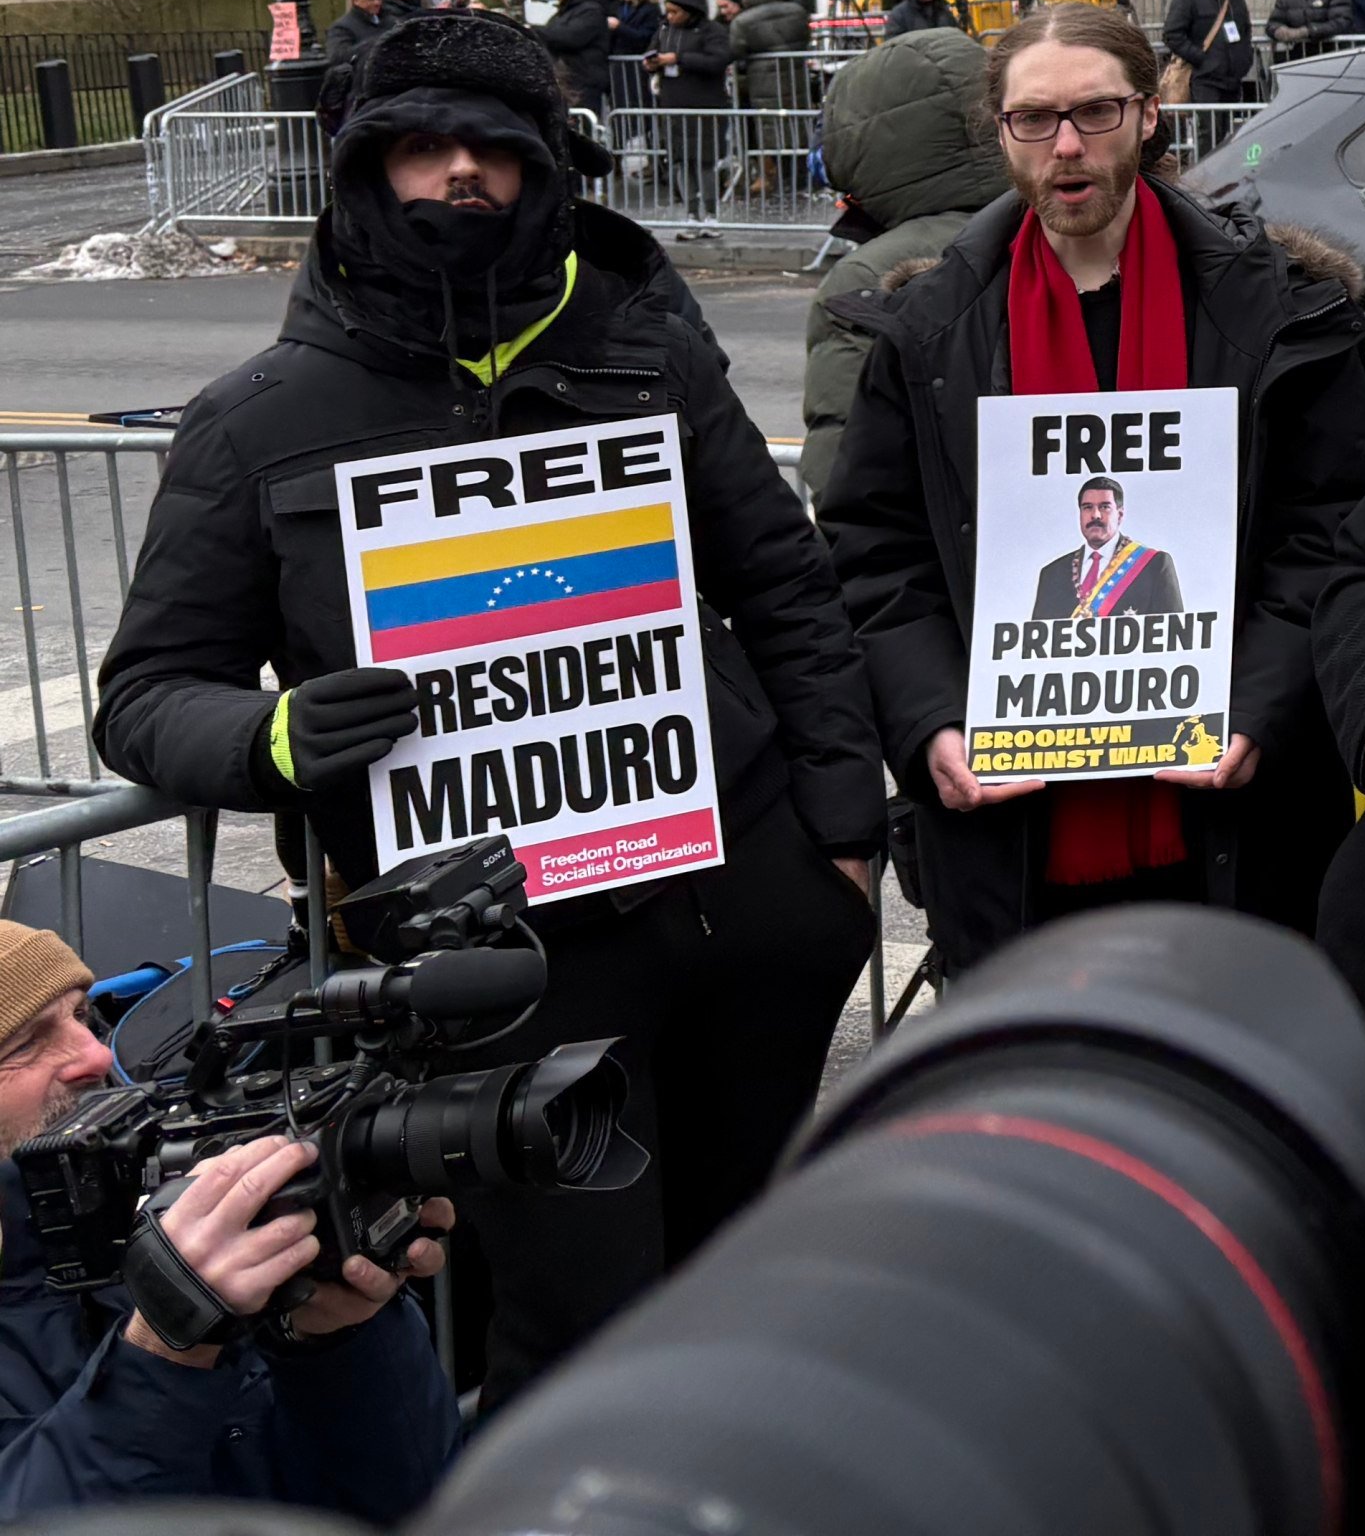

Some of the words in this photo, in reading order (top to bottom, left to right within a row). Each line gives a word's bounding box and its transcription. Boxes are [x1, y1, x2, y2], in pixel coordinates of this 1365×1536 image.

[1031, 411, 1182, 476] FREE
[351, 430, 672, 531] FREE
[991, 611, 1218, 661] PRESIDENT
[408, 624, 685, 739] RESIDENT
[995, 664, 1200, 719] MADURO
[971, 748, 1102, 772] AGAINST
[1108, 743, 1177, 767] WAR
[972, 725, 1131, 750] BROOKLYN
[389, 714, 697, 851] MADURO
[482, 847, 507, 868] SONY
[540, 846, 613, 870] Freedom
[616, 833, 658, 853] Road
[542, 861, 610, 887] Socialist
[613, 840, 712, 872] Organization
